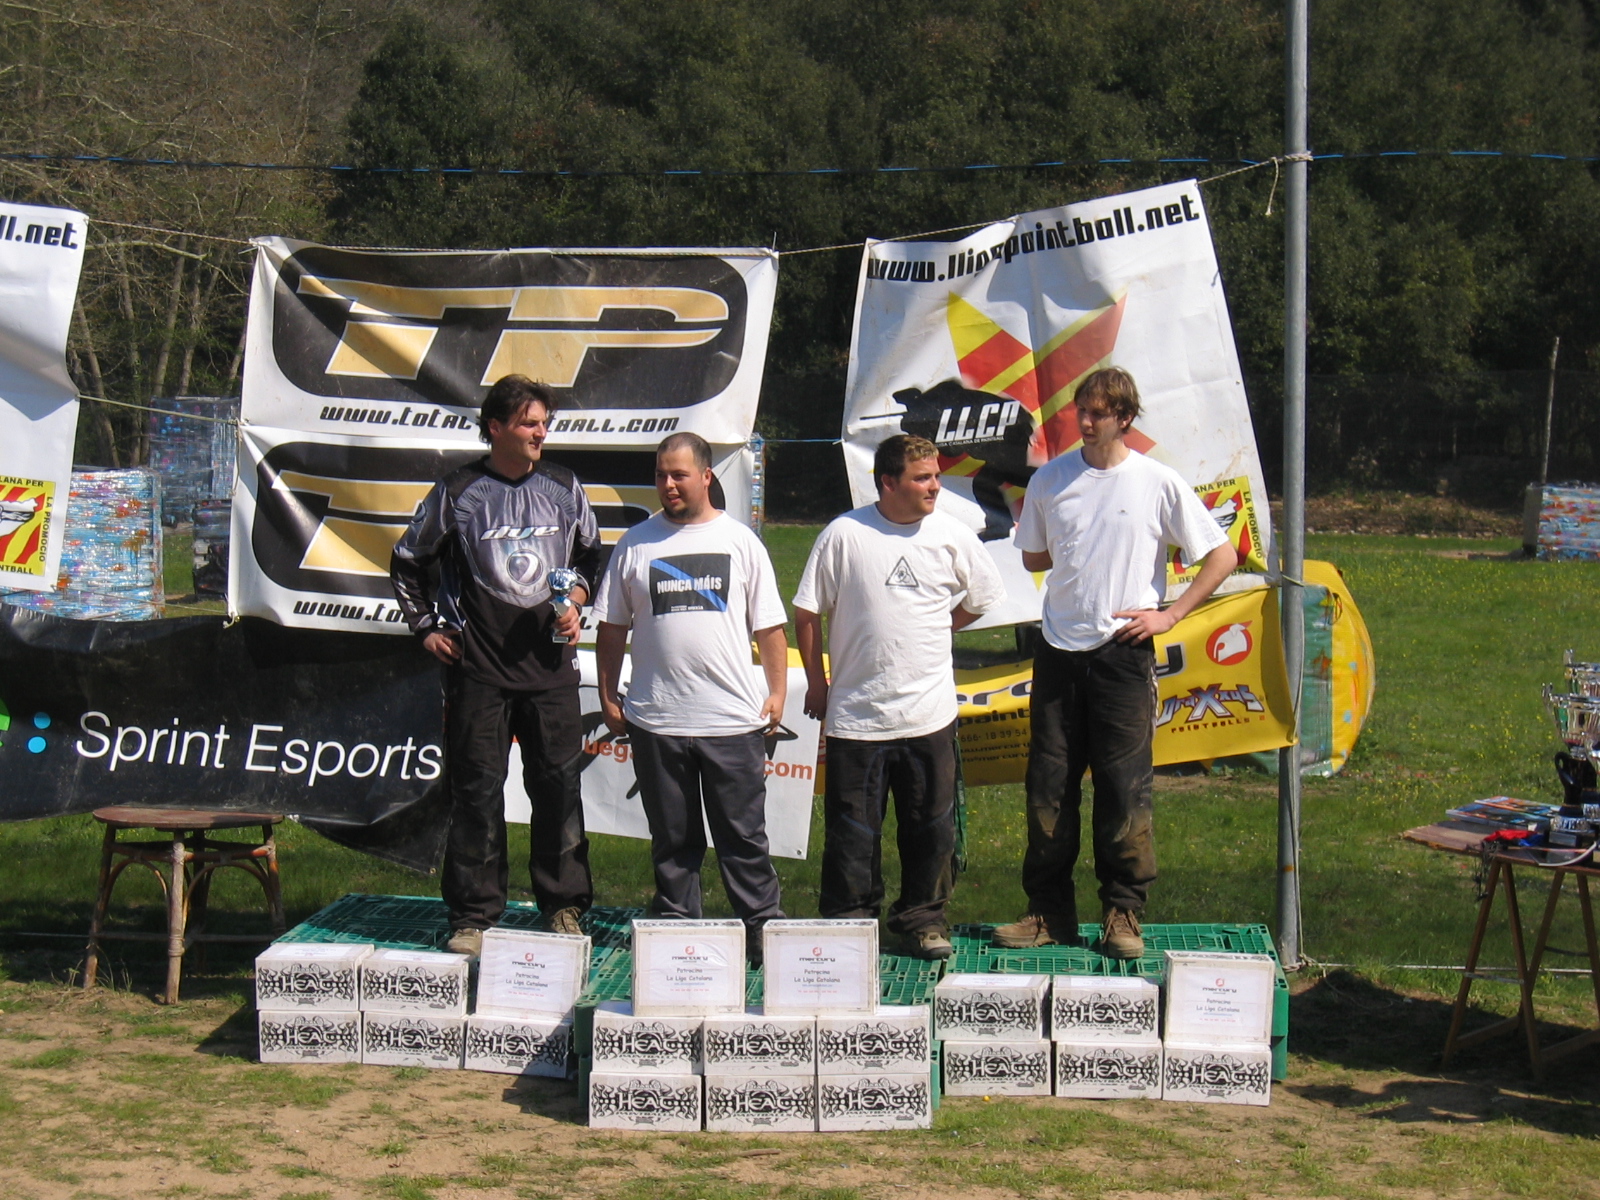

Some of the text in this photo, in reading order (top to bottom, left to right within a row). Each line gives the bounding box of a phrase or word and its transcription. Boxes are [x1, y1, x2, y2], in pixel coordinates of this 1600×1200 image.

[935, 400, 1020, 443] LLCP
[25, 479, 44, 488] PER
[1217, 479, 1236, 489] PER
[1243, 491, 1251, 504] LA
[656, 574, 722, 594] NUNCA MÁIS
[75, 710, 442, 787] Sprint Esports
[281, 975, 334, 992] HEAT
[388, 977, 439, 996] HEAT
[962, 1005, 1015, 1021] HEAT
[1080, 1006, 1133, 1022] HEAT
[286, 1028, 338, 1044] HEAT
[390, 1030, 441, 1049] HEAT
[621, 1035, 678, 1053] HEAT
[492, 1036, 544, 1055] HEAT
[733, 1037, 790, 1054] HEAT
[847, 1037, 904, 1054] HEAT
[972, 1060, 1026, 1077] HEAT
[1084, 1061, 1137, 1078] HEAT
[1192, 1066, 1246, 1084] HEAT
[618, 1092, 676, 1110] HEAT
[735, 1094, 793, 1112] HEAT
[848, 1092, 905, 1110] HEAT
